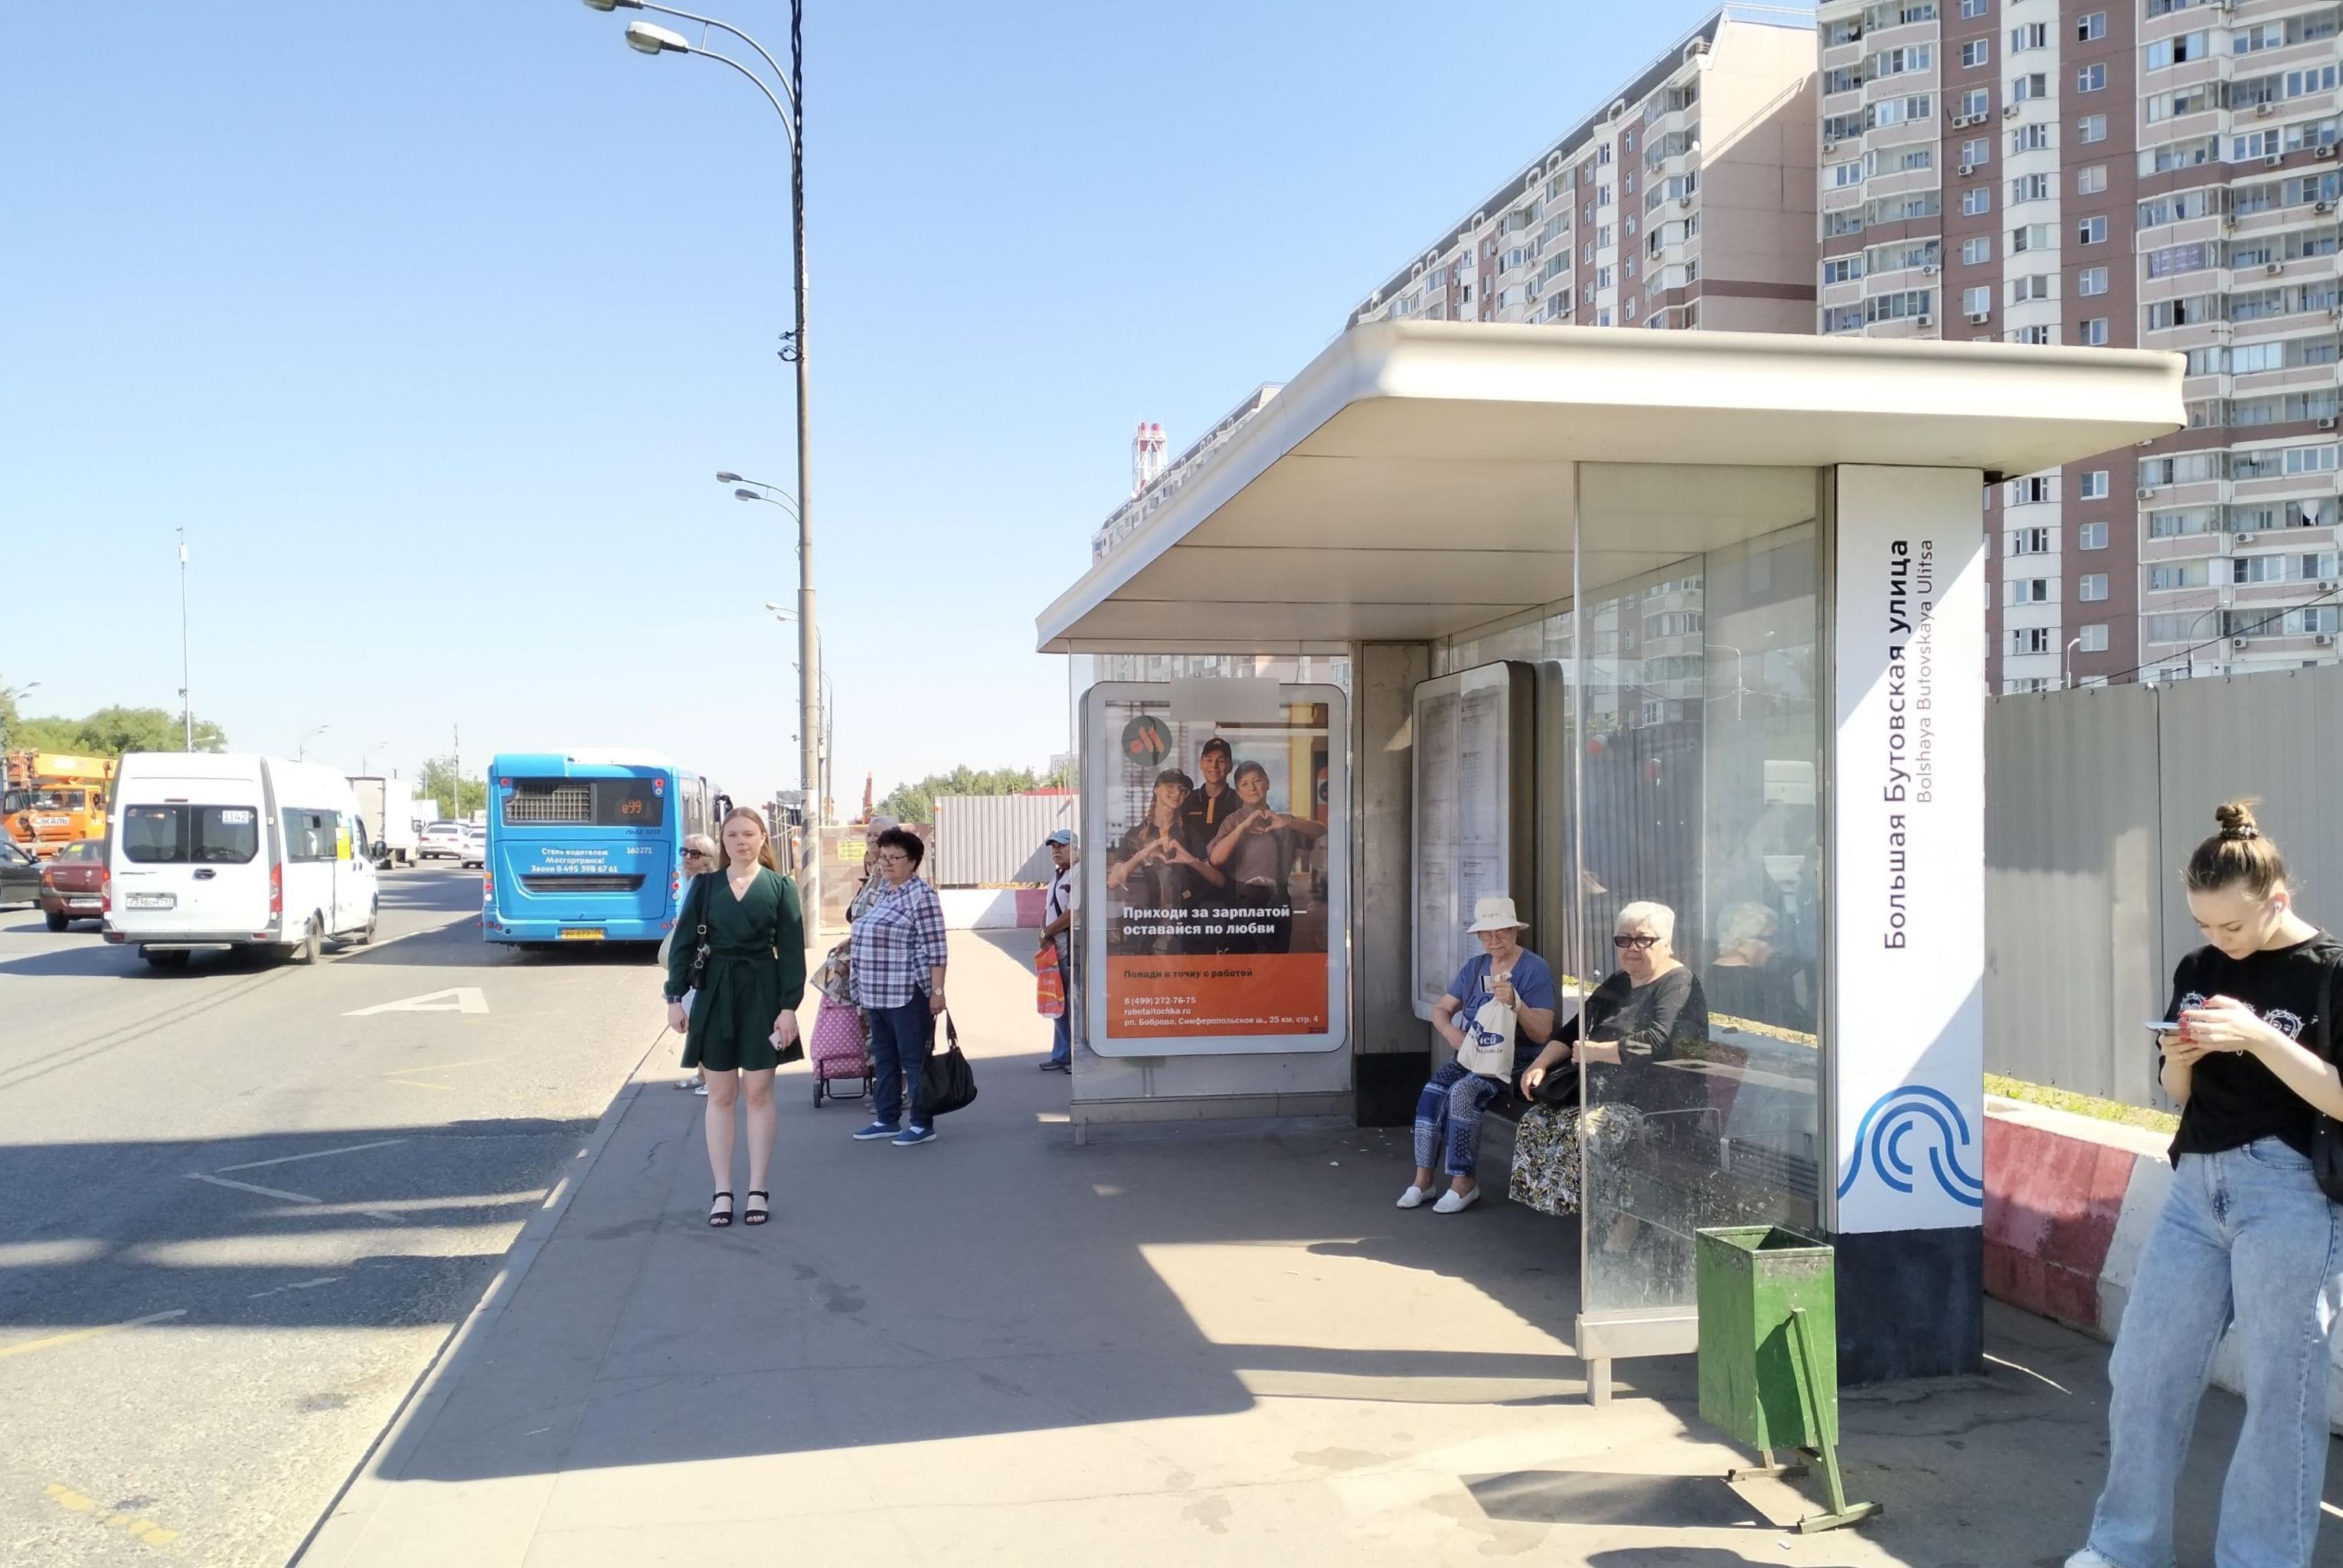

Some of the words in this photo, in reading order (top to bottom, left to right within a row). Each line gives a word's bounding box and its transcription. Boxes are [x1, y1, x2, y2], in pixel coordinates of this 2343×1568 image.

[1917, 540, 1933, 593] Ulitsa
[1890, 540, 1911, 634] улица
[1916, 601, 1935, 710] Butovskaya
[1884, 645, 1910, 802] Бутовская
[1916, 718, 1935, 802] Bolshaya
[224, 812, 247, 822] 1142
[1884, 815, 1906, 949] Большая
[1123, 906, 1188, 920] Приходи
[1191, 908, 1208, 918] за
[1212, 905, 1290, 920] зарплатой
[1123, 923, 1201, 935] оставайся
[1205, 925, 1223, 935] по
[1226, 923, 1275, 934] любви
[1124, 971, 1162, 979] Попади
[1172, 971, 1201, 979] точку
[1211, 969, 1253, 978] работой
[1131, 998, 1153, 1006] (499)
[1178, 1017, 1254, 1025] Симферопольское
